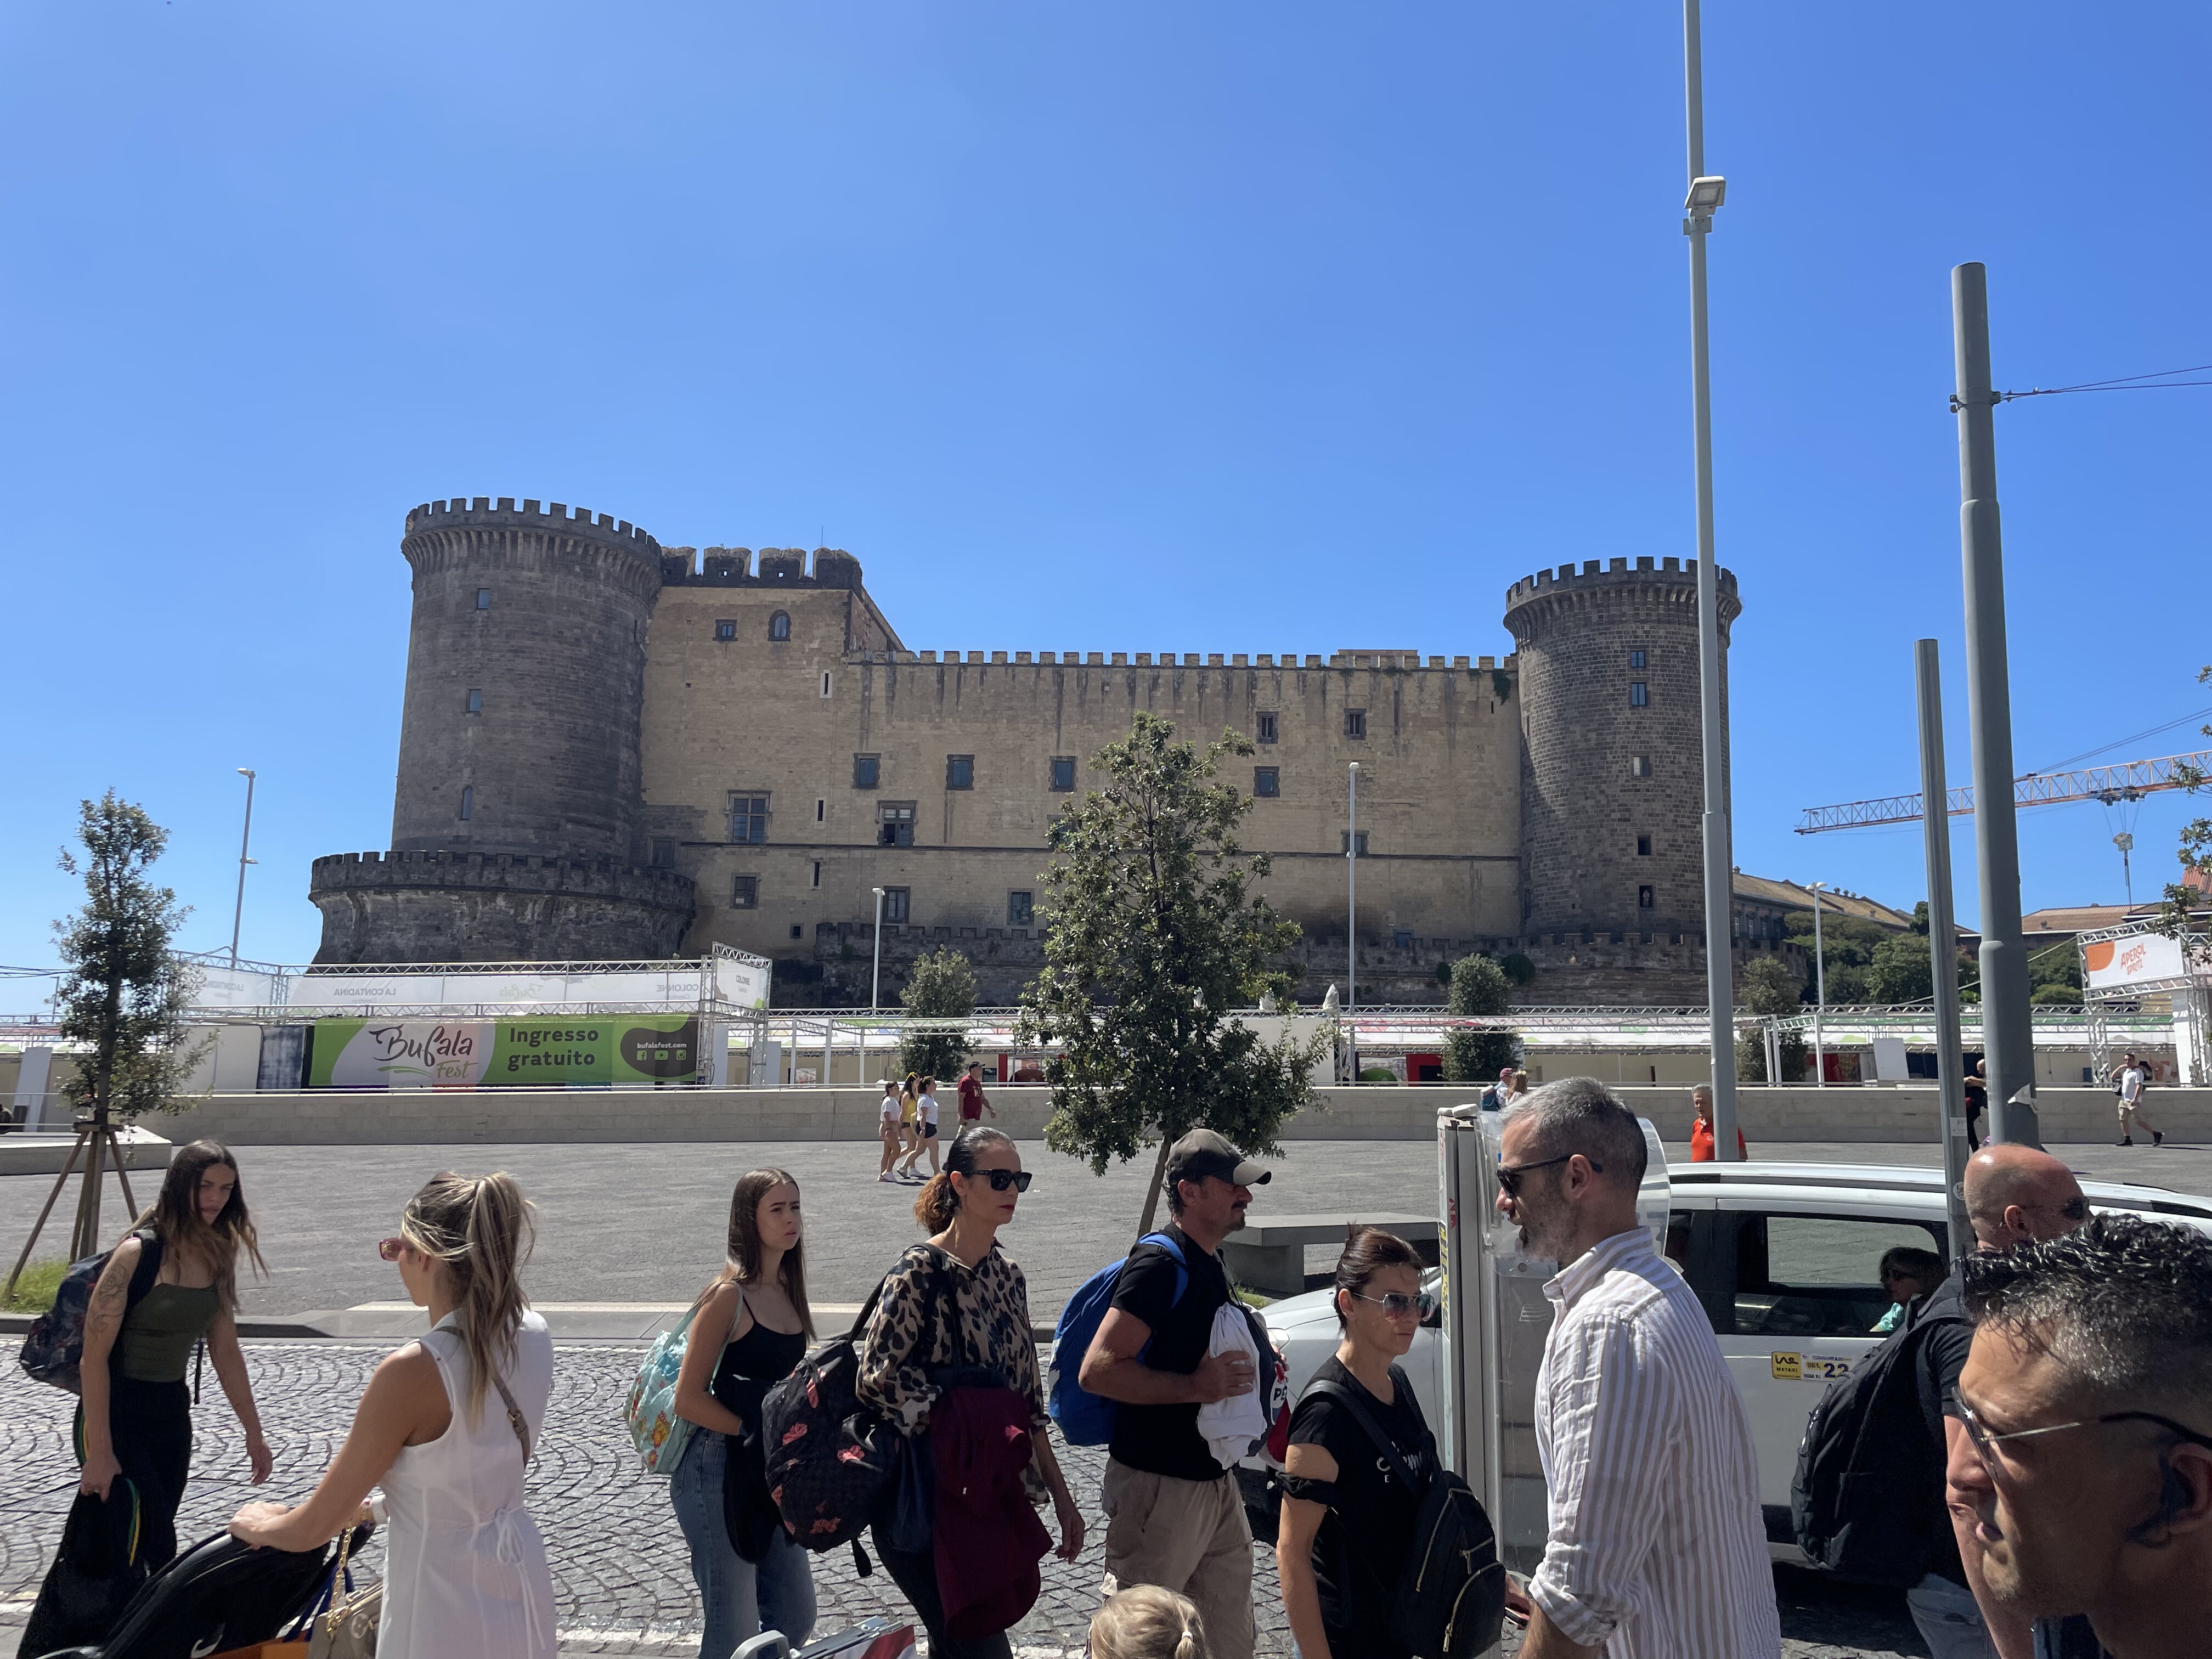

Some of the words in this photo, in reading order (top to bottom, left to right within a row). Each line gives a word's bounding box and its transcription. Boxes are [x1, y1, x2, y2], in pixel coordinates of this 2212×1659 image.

[2120, 943, 2146, 969] APEROL
[369, 1023, 473, 1067] Bufala
[510, 1028, 599, 1047] Ingresso
[437, 1060, 479, 1079] Fest
[507, 1049, 595, 1071] gratuito
